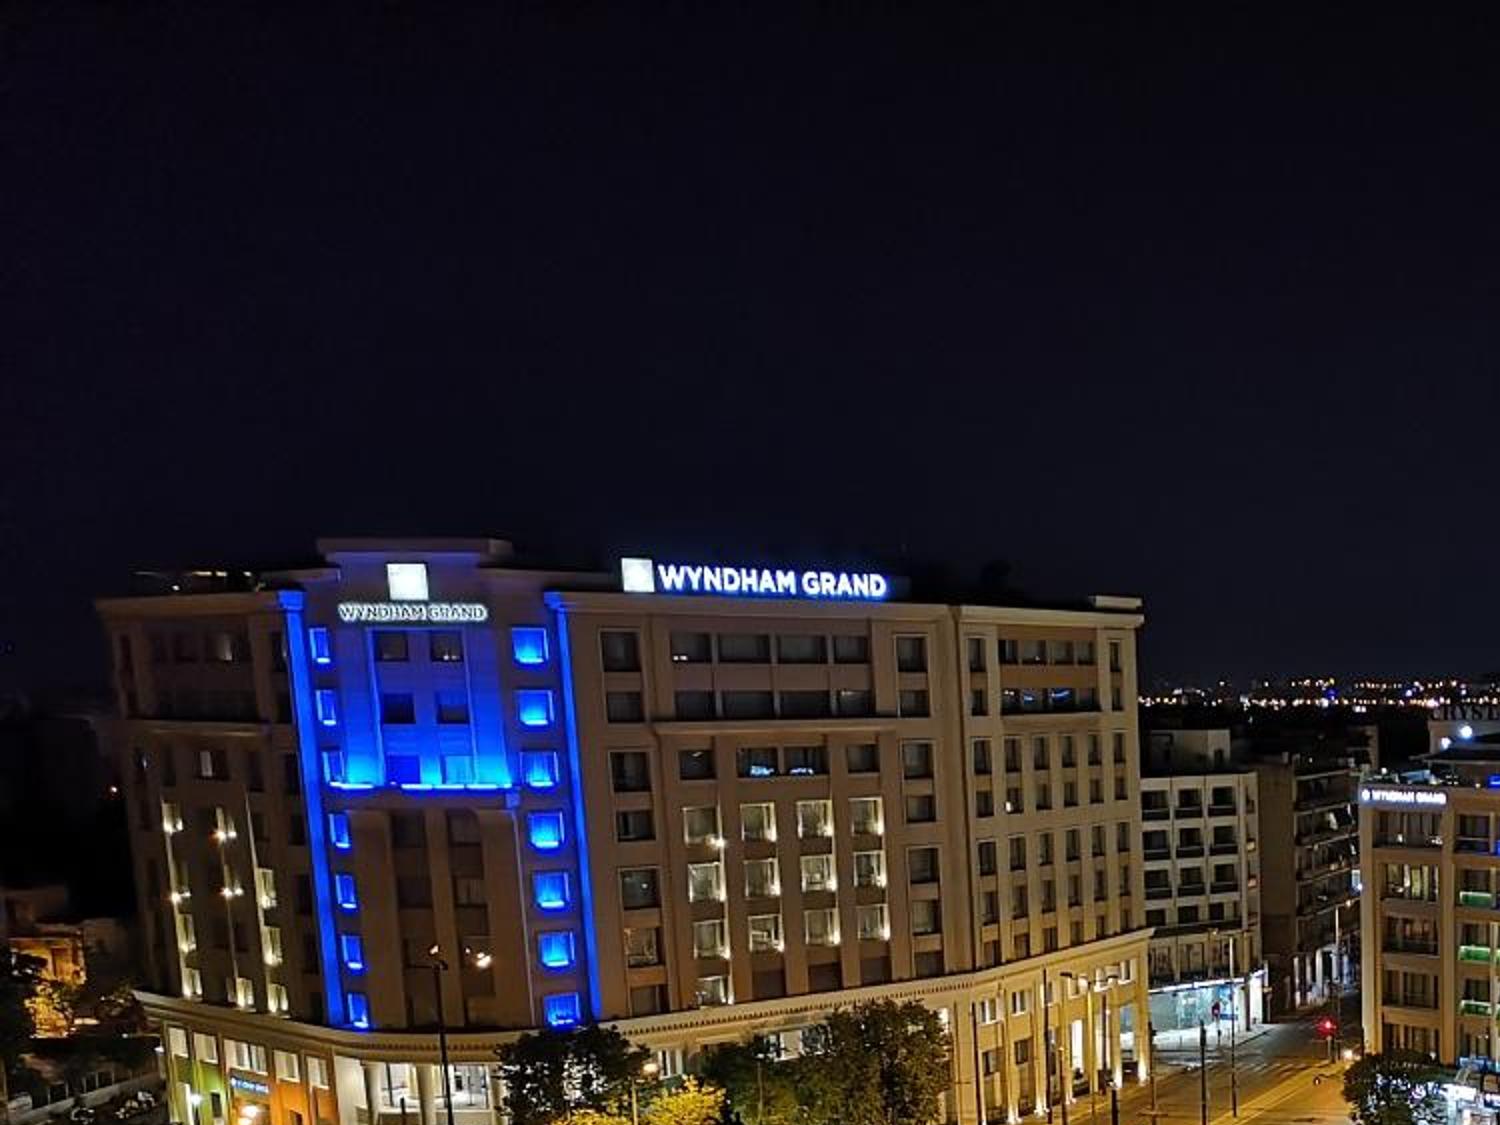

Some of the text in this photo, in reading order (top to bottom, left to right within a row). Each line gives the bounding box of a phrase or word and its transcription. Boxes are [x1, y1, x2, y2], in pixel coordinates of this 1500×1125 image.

[657, 564, 888, 597] WYNDHAM GRAND
[337, 601, 488, 622] WYNDHAM GRAND
